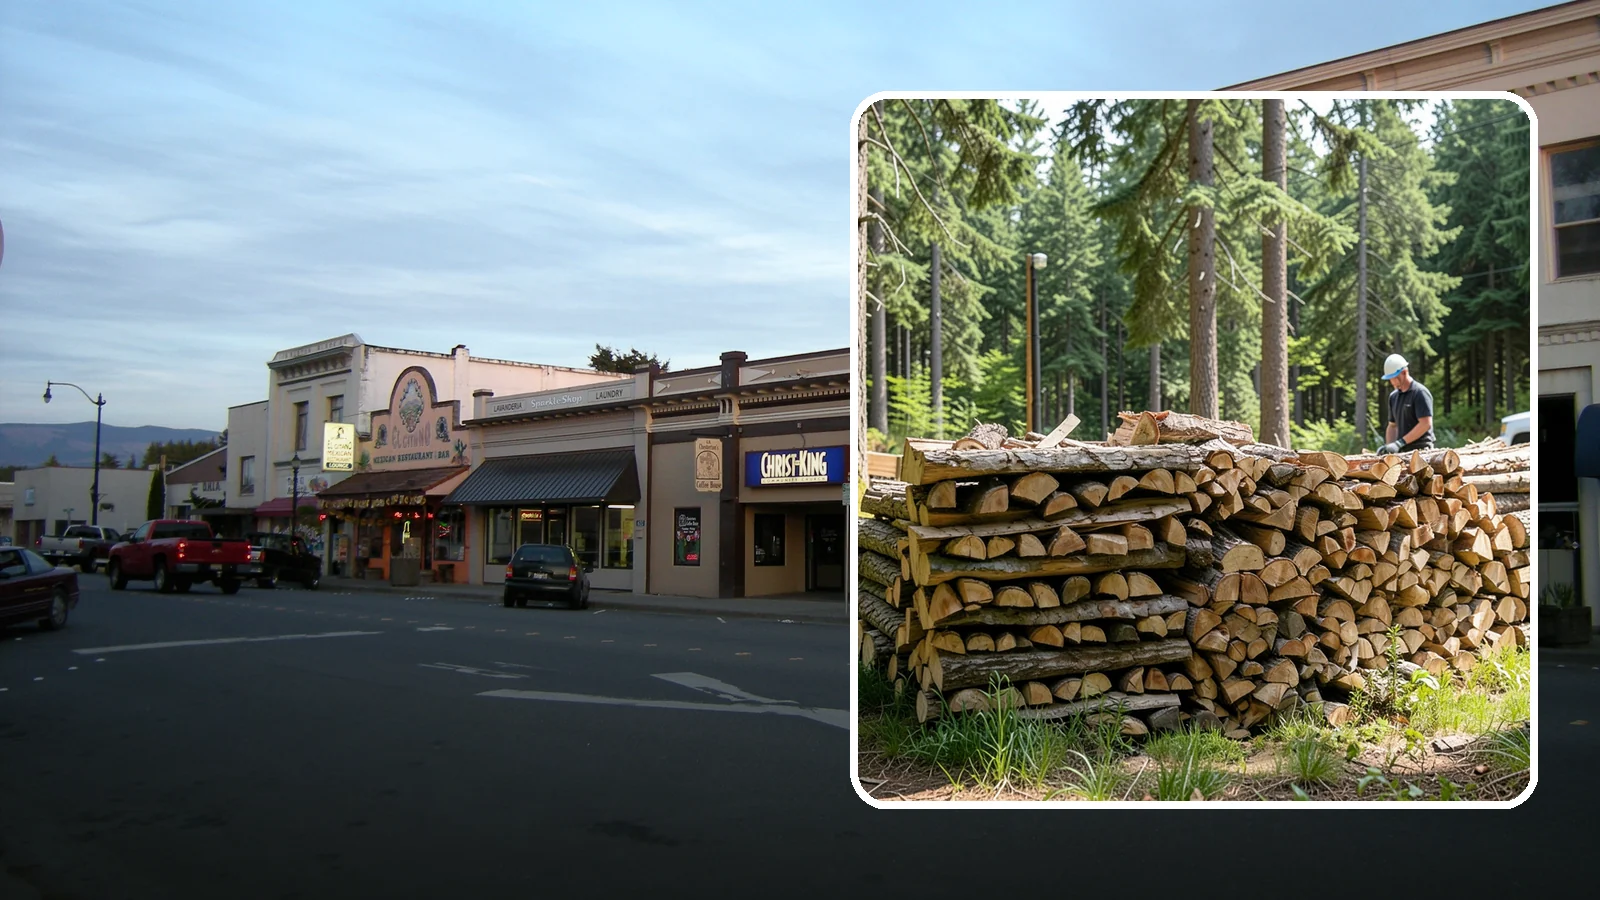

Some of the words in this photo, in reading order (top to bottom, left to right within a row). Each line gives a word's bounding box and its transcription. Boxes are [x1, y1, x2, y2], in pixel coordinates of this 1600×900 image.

[595, 389, 624, 399] LAUNDRY
[494, 402, 522, 412] LAVANDERIA
[530, 396, 561, 409] Sparkle
[562, 395, 582, 404] Shop
[392, 425, 401, 449] EL
[373, 454, 396, 464] MEXICAN
[397, 451, 433, 462] RESTAURANT
[438, 450, 450, 459] BAR
